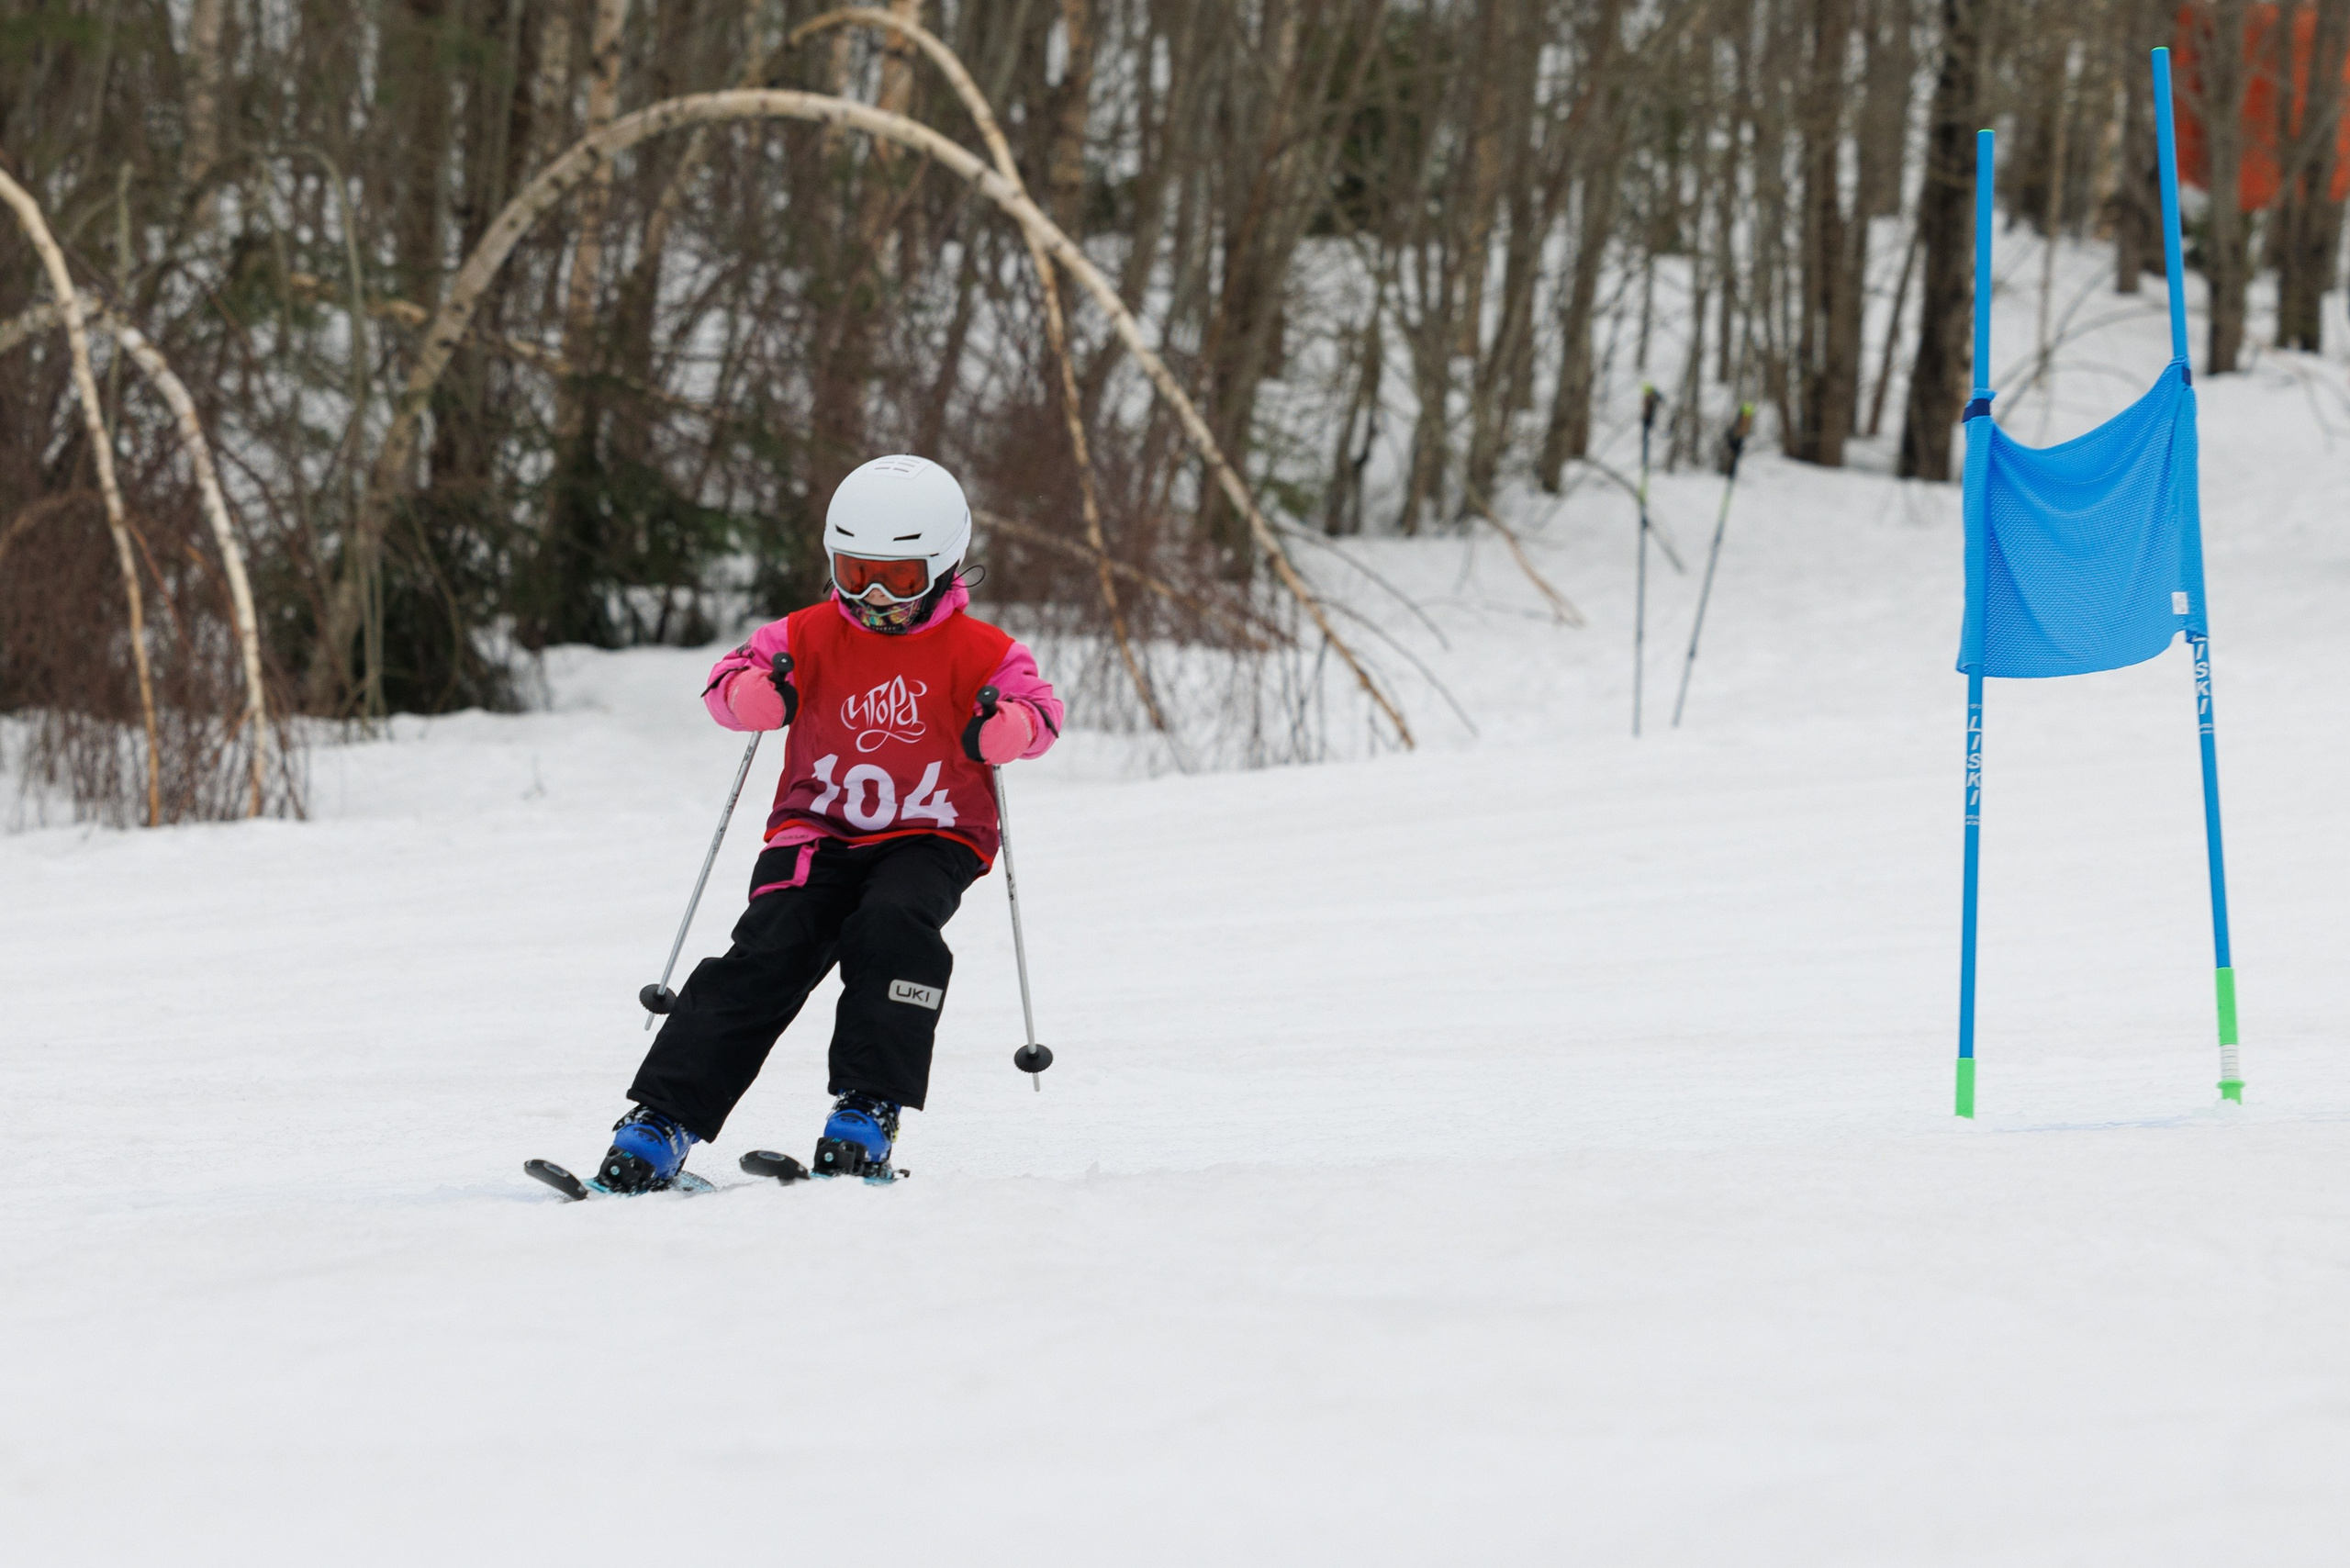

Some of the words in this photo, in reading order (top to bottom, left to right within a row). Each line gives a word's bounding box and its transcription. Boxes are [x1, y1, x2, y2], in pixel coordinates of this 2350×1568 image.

[810, 753, 959, 831] 104
[1966, 715, 1982, 806] LISKI
[896, 985, 930, 1002] UKI
